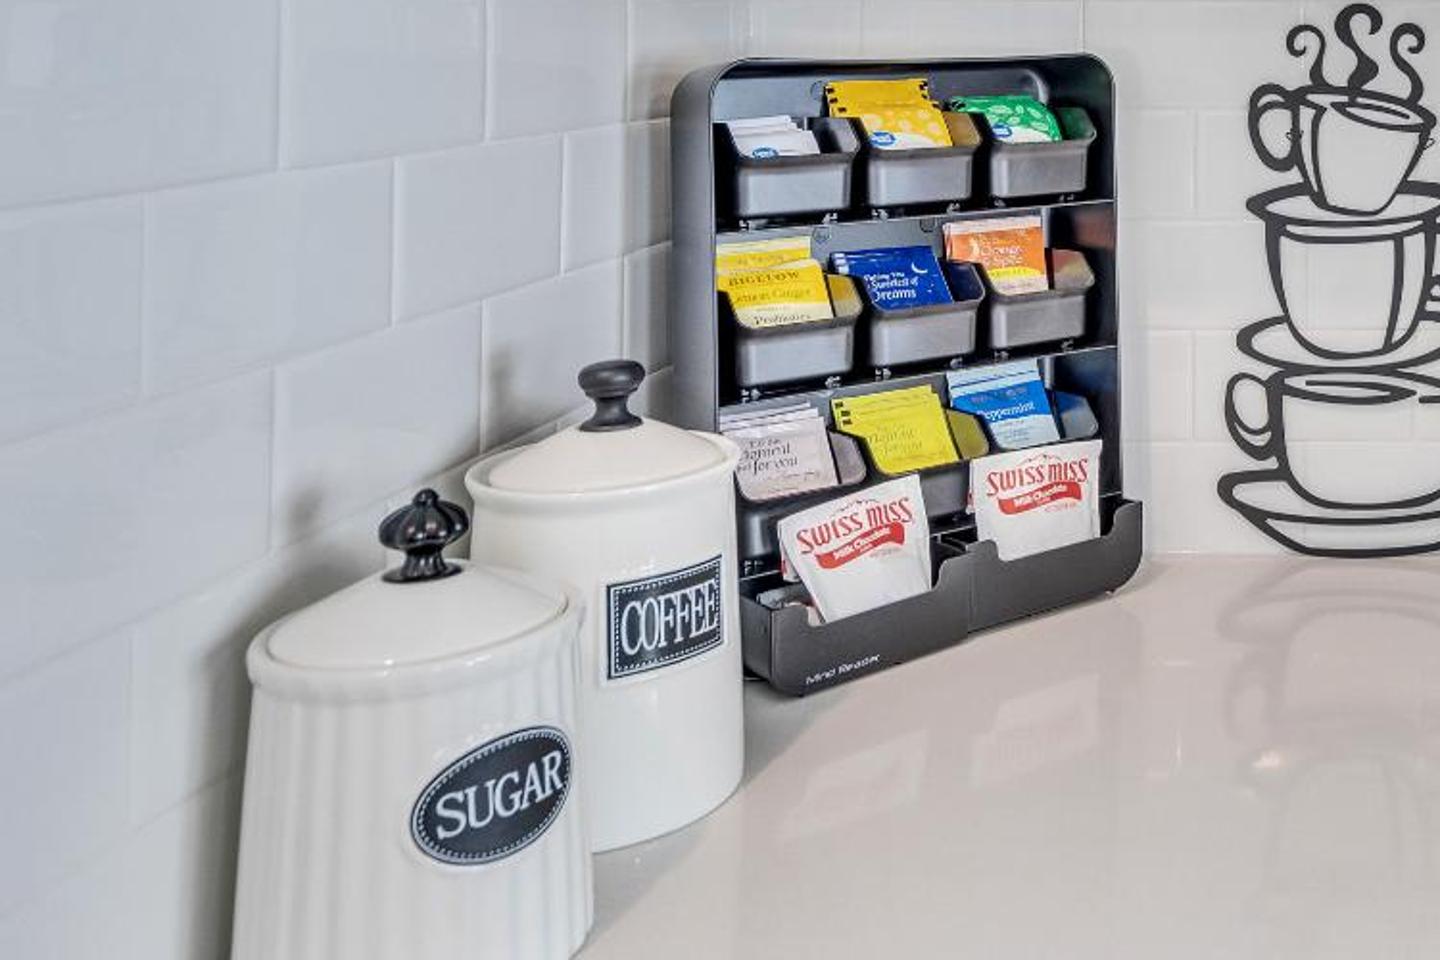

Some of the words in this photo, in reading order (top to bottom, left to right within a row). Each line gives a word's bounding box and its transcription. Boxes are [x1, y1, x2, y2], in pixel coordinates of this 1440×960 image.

[987, 465, 1046, 497] SWISS
[796, 512, 863, 554] SWISS
[620, 578, 719, 656] COFFEE
[436, 751, 564, 840] SUGAR
